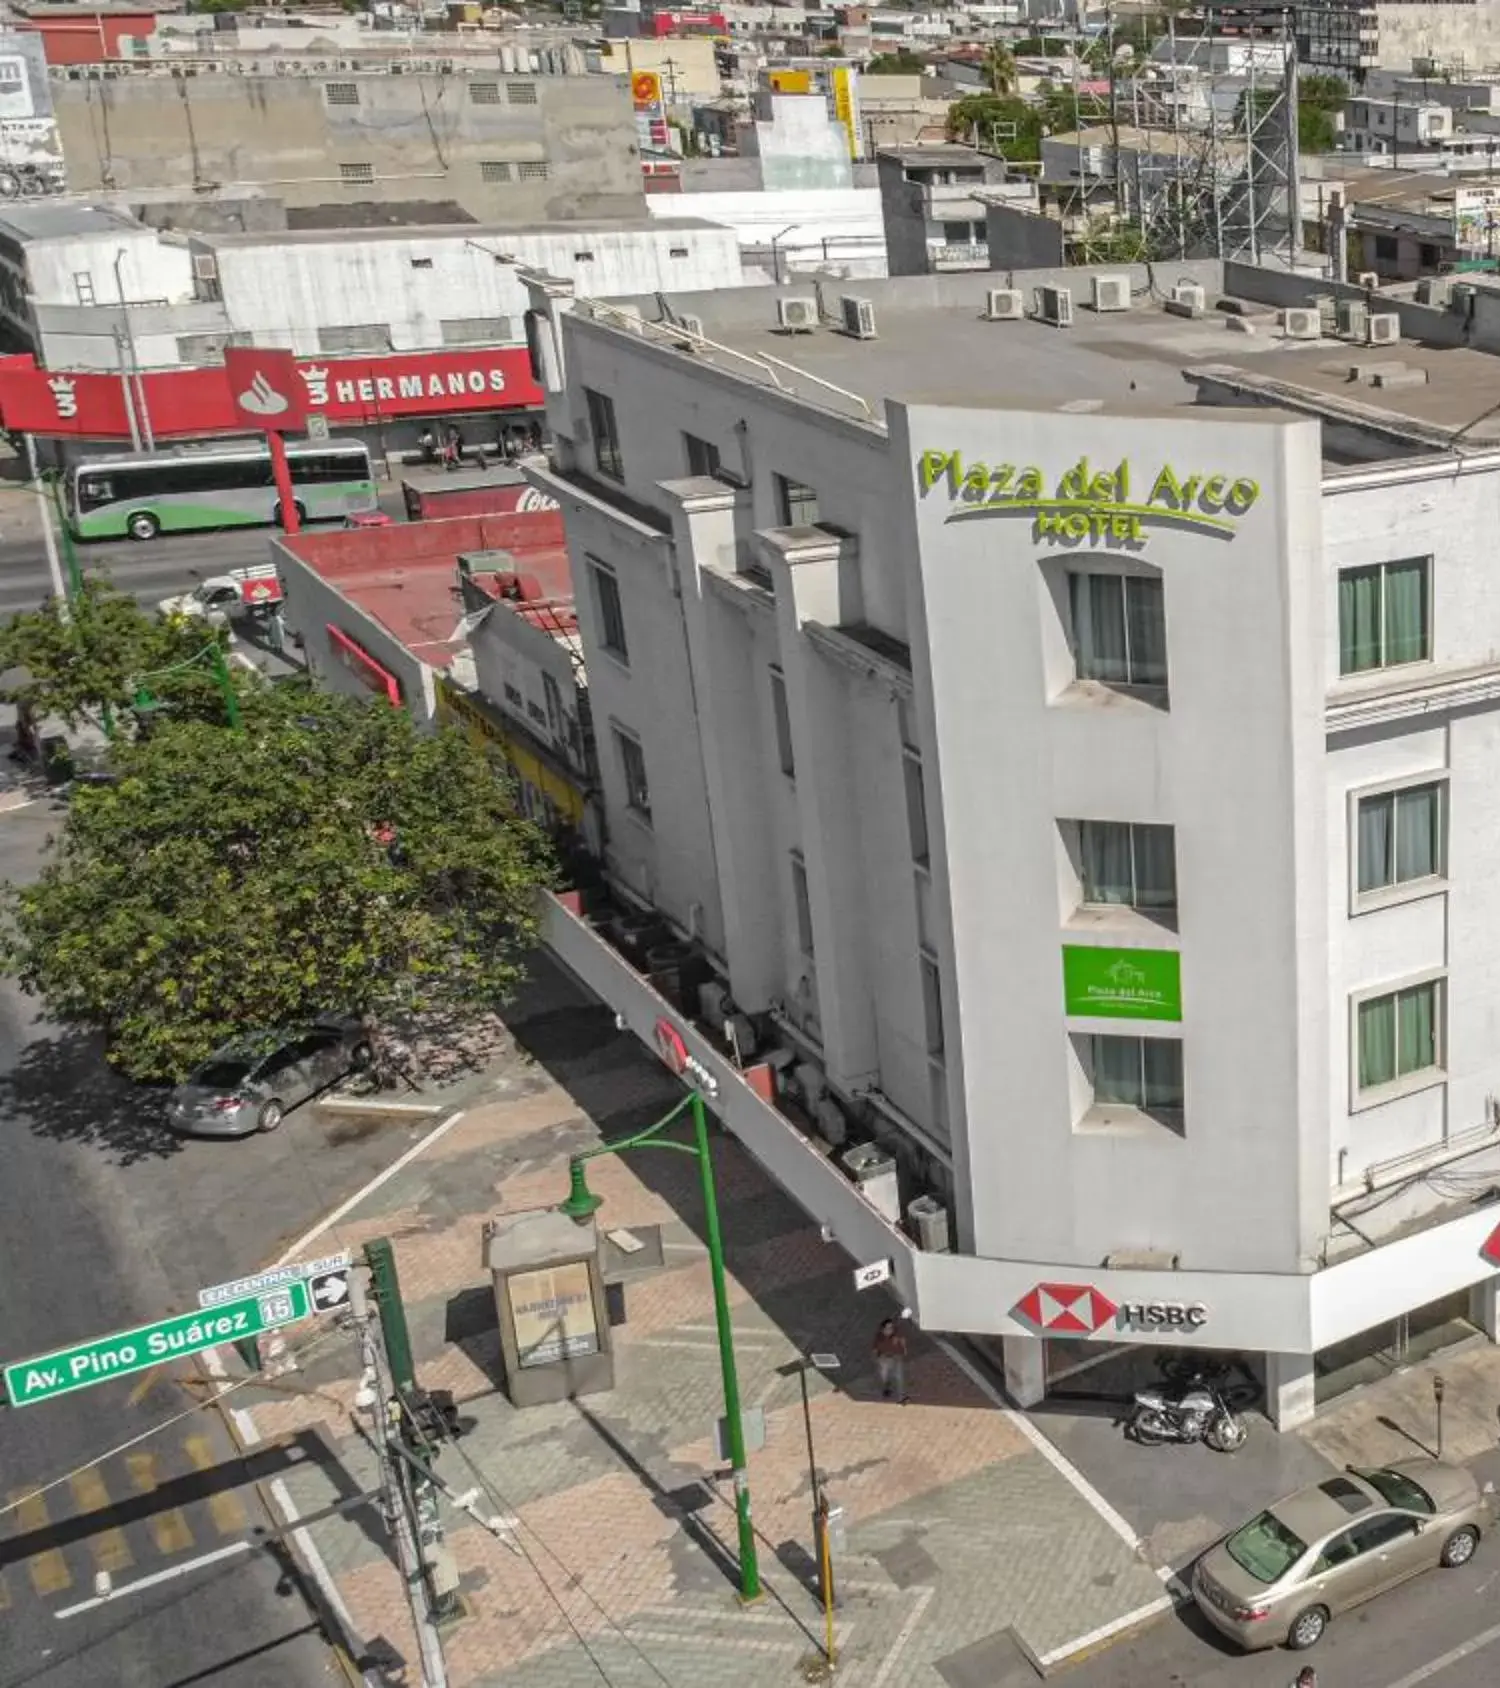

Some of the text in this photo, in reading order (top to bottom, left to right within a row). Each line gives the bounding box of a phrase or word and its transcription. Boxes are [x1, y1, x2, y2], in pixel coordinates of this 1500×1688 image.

[336, 369, 505, 404] HERMANOS
[922, 449, 1260, 502] Plaza del Arco
[1037, 512, 1148, 540] HOTEL
[313, 1255, 343, 1270] SUR
[1123, 1305, 1207, 1326] HSBC
[25, 1300, 291, 1394] Av. Pino Suárez 15
